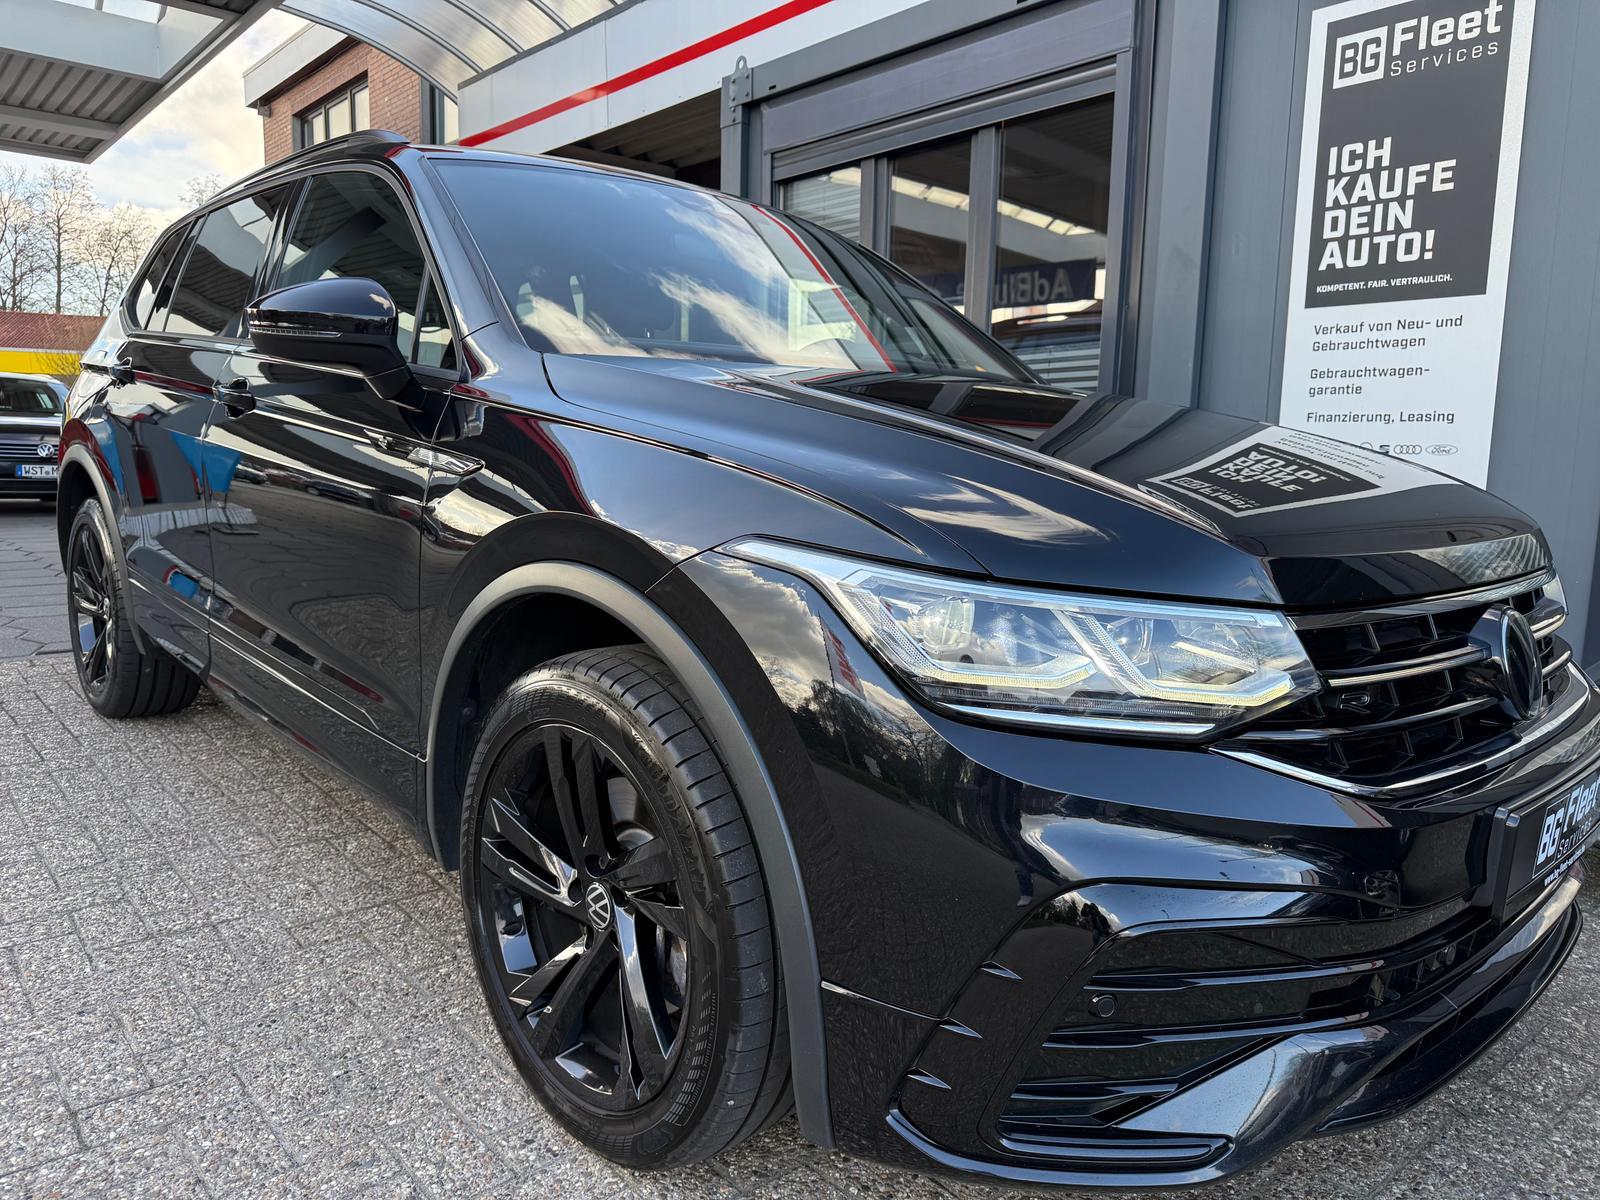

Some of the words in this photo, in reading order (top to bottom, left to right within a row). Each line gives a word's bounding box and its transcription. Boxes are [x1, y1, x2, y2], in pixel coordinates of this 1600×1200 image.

[1338, 36, 1383, 80] BG
[1392, 0, 1503, 56] Fleet
[1390, 41, 1499, 76] Services
[1328, 136, 1392, 176] ICH
[1325, 159, 1457, 208] KAUFE
[1322, 199, 1414, 239] DEIN
[1318, 229, 1436, 271] AUTO!
[1316, 281, 1367, 293] KOMPETENT.
[1367, 278, 1389, 289] FAIR.
[1390, 273, 1453, 287] VERTRAULICH.
[1314, 321, 1365, 336] Verkauf
[1368, 321, 1392, 332] von
[1396, 318, 1432, 330] Neu-
[1435, 315, 1463, 328] und
[1312, 335, 1426, 352] Gebrauchtwagen
[1310, 366, 1430, 379] Gebrauchtwagen-
[1308, 384, 1363, 397] garantie
[1306, 411, 1395, 424] Finanzierung,
[1399, 411, 1455, 425] Leasing
[24, 466, 44, 475] WST
[1537, 807, 1565, 866] BG
[1557, 817, 1592, 858] Services
